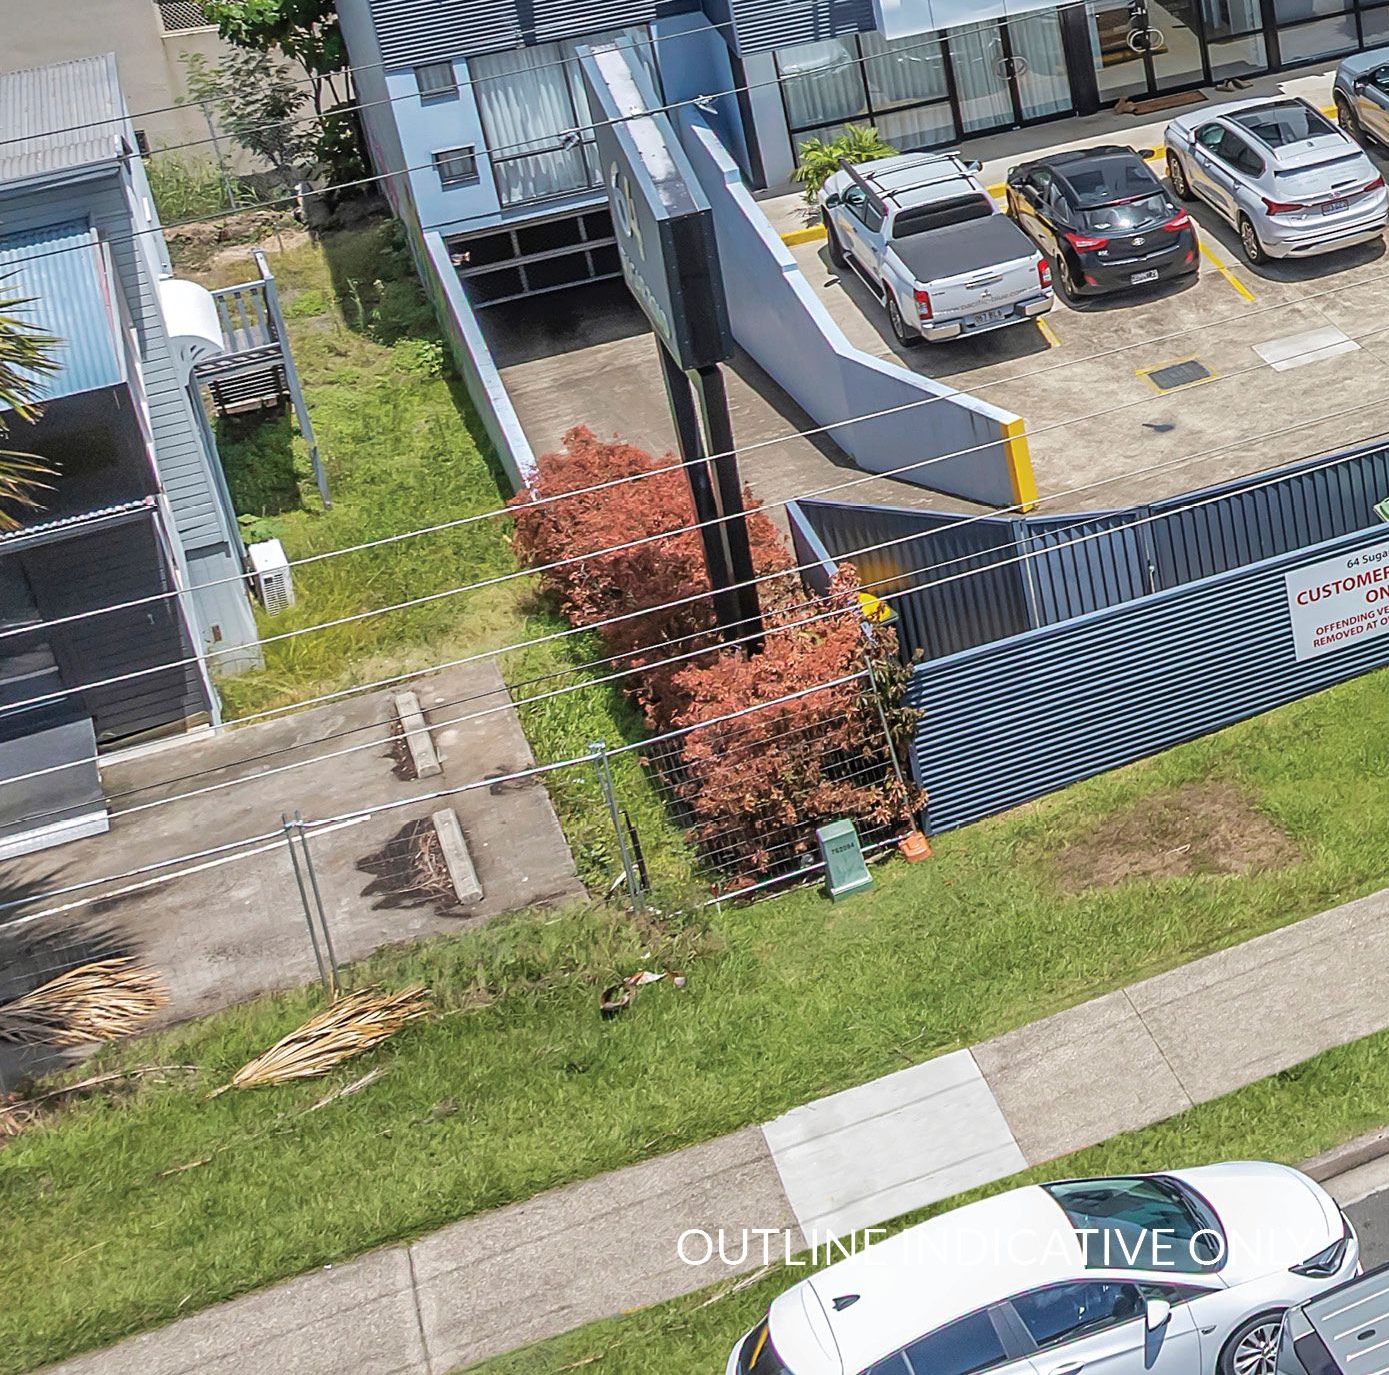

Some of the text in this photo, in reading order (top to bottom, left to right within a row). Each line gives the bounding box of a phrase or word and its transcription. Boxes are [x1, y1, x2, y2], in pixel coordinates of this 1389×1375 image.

[1346, 557, 1360, 569] 64
[1313, 625, 1364, 648] REMOVED
[1366, 620, 1377, 631] AT
[1315, 610, 1375, 636] OFFENDING
